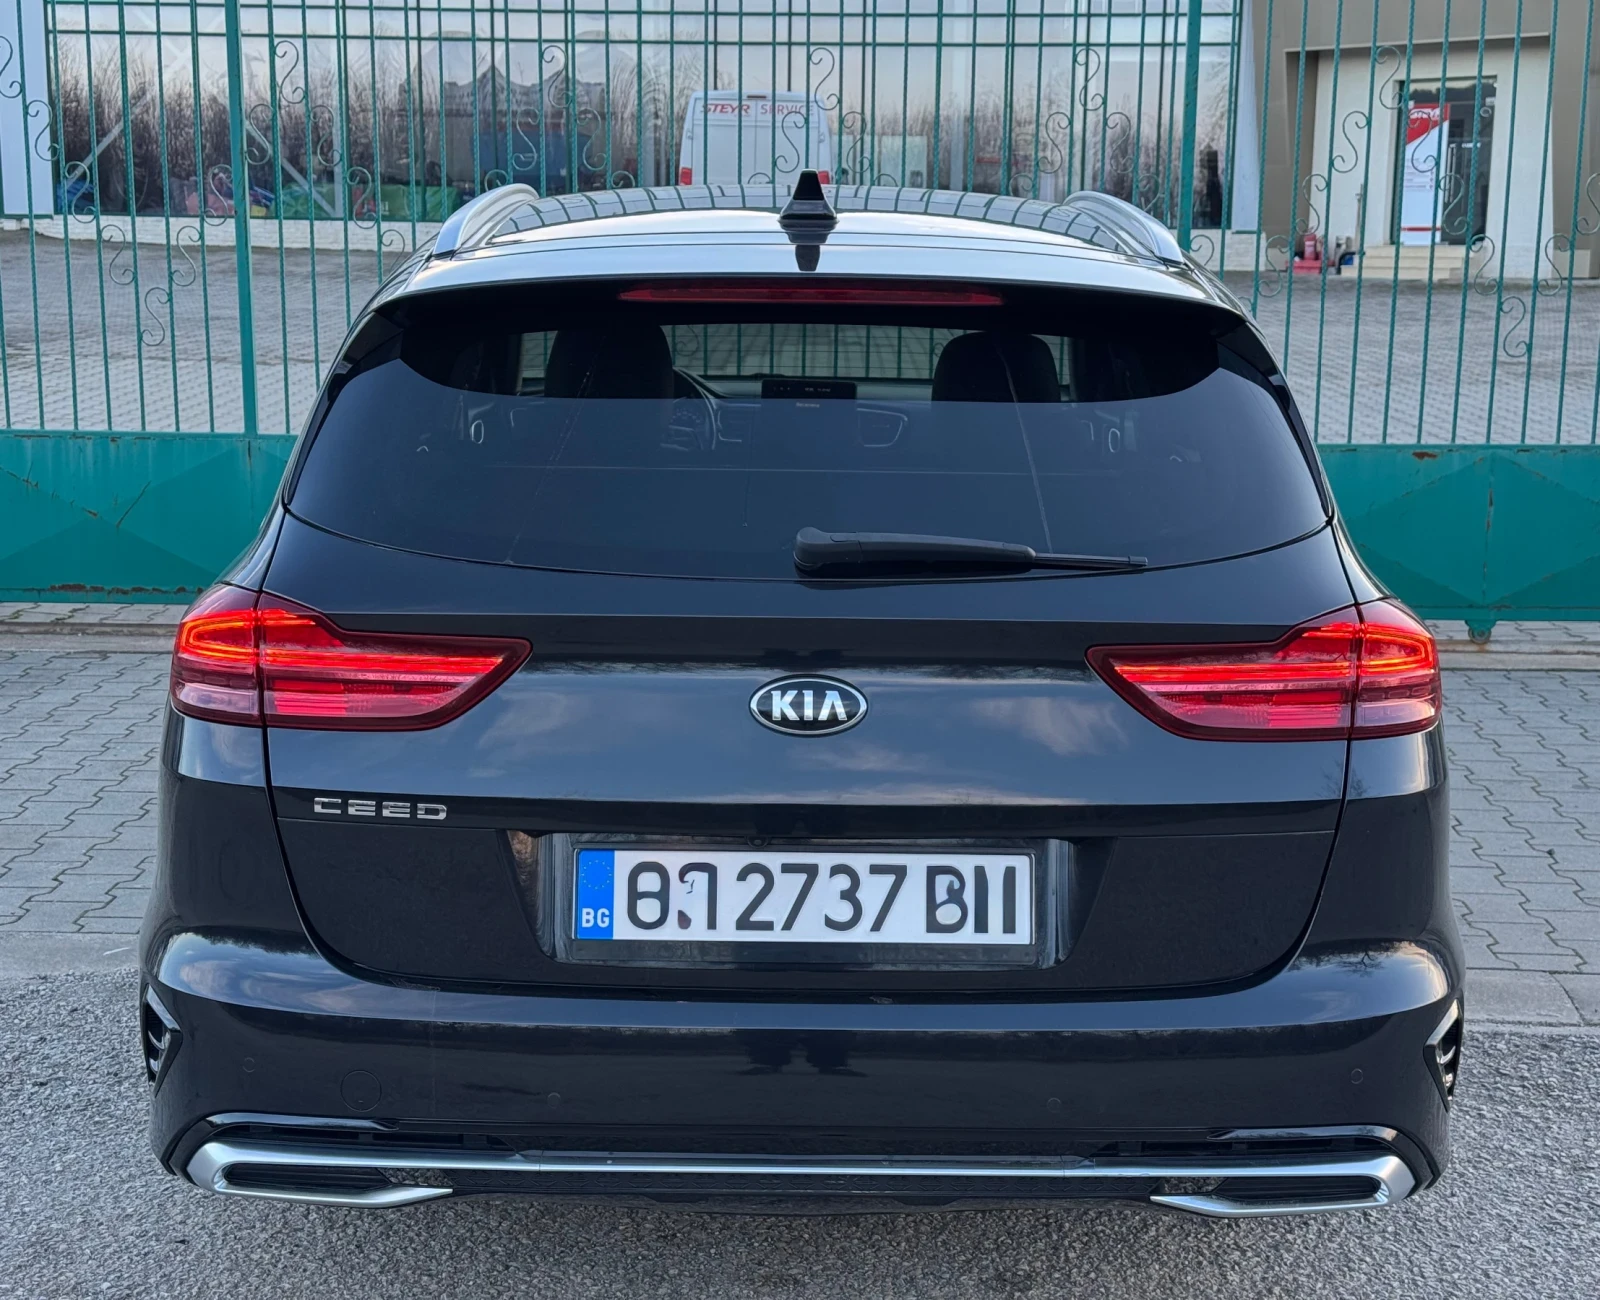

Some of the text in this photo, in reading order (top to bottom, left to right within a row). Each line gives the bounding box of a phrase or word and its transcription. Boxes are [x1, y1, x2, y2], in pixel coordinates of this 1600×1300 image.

[702, 103, 815, 115] STEYR SERVICE
[770, 690, 848, 721] KIA
[313, 797, 448, 821] CEED
[581, 907, 610, 929] BG
